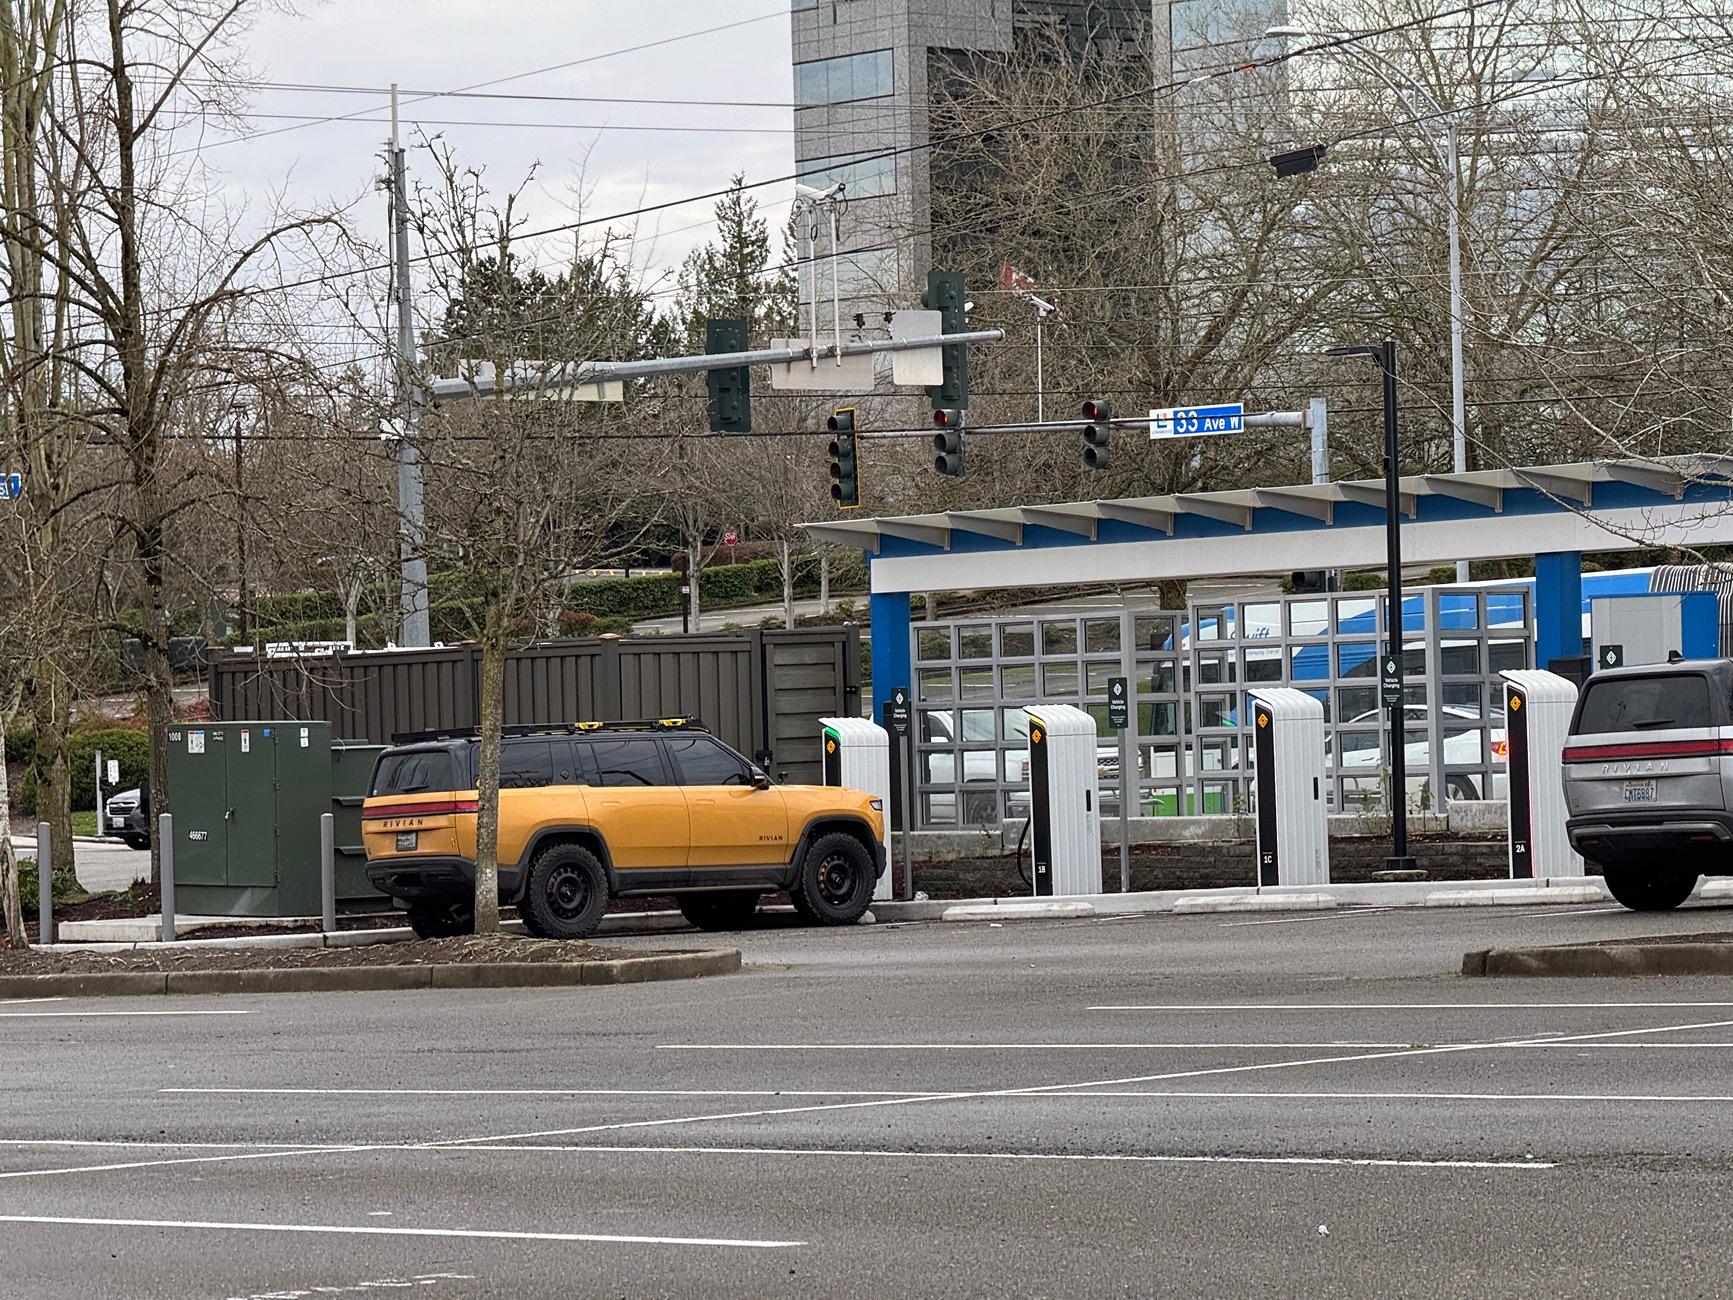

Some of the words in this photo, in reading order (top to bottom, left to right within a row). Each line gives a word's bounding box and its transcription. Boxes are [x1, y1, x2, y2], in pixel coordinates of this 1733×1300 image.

[1176, 411, 1198, 433] 33
[1204, 418, 1226, 431] Ave
[1230, 416, 1239, 429] W
[1602, 761, 1669, 774] RIVIAN
[383, 819, 424, 828] RIVIAN
[1515, 844, 1526, 853] 2A
[1263, 855, 1273, 864] 1C
